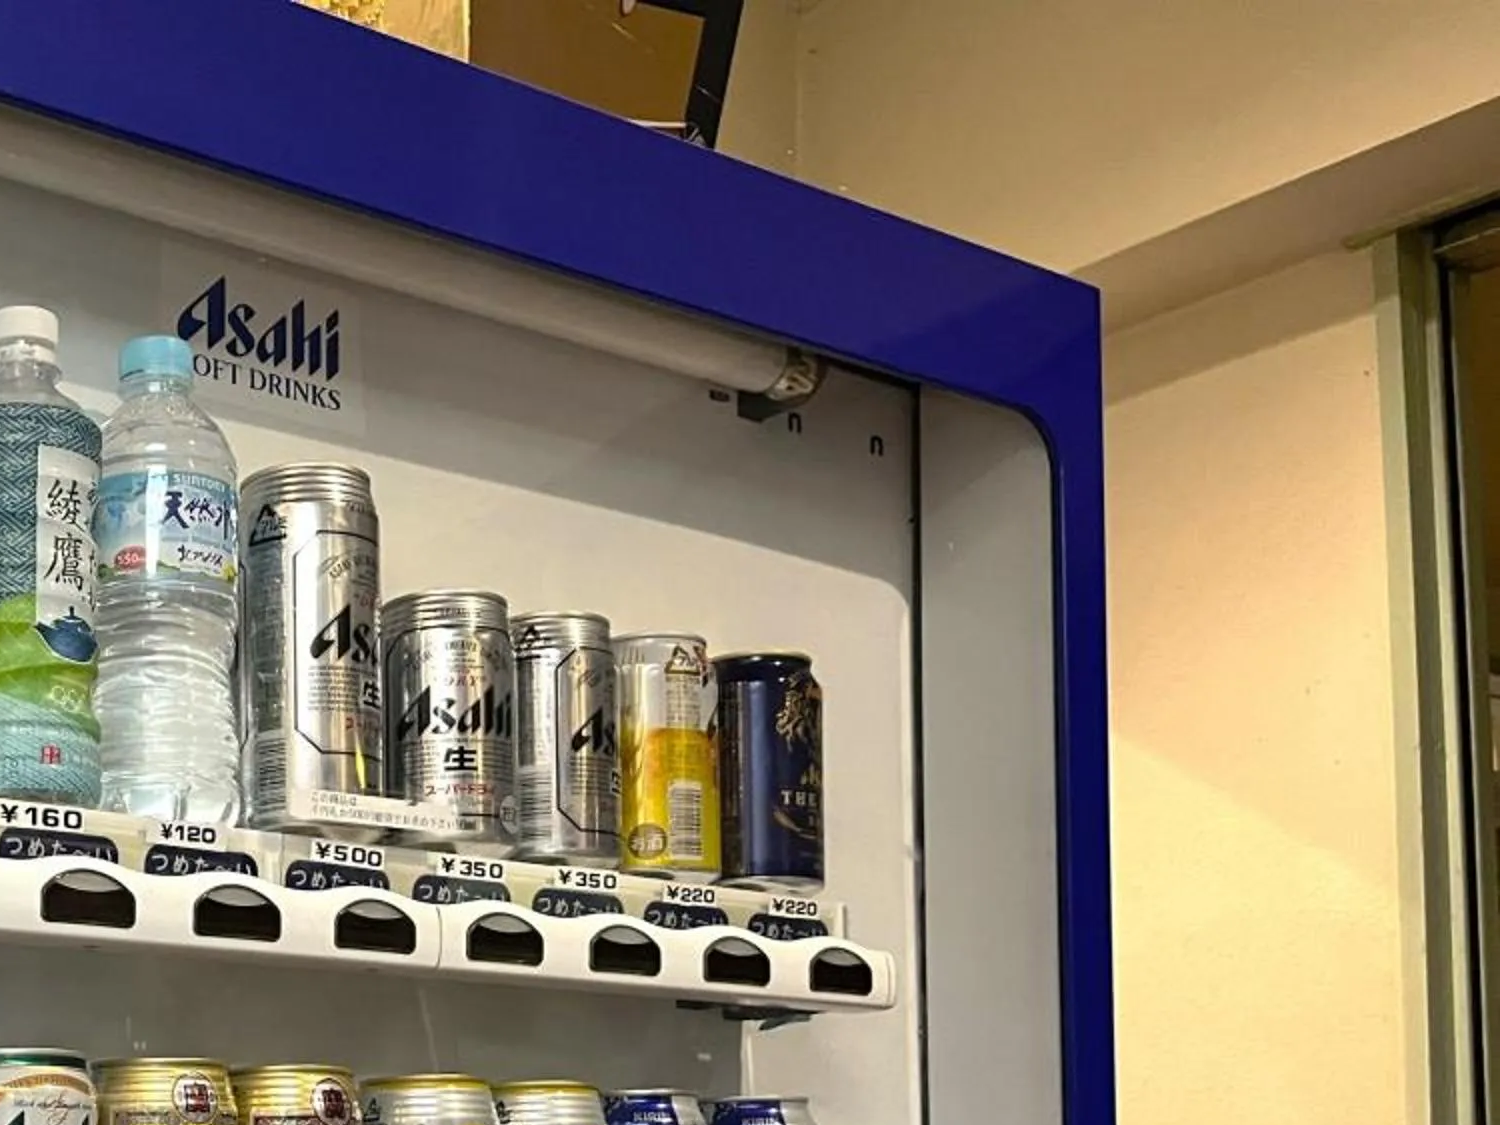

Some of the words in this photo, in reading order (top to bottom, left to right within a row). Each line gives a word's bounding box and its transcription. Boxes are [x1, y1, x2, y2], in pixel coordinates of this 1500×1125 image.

[178, 275, 339, 381] Asahi
[193, 353, 242, 385] OFT
[250, 368, 341, 411] DRINKS
[43, 479, 84, 592] 綾鷹
[398, 685, 511, 742] Asahi
[444, 746, 478, 772] 生
[781, 789, 818, 806] THE
[0, 804, 82, 830] ¥160
[160, 823, 216, 845] ¥120
[315, 841, 383, 867] ¥500
[441, 857, 503, 878] ¥350
[558, 869, 617, 889] ¥350
[667, 885, 715, 903] ¥220
[771, 898, 818, 916] ¥220
